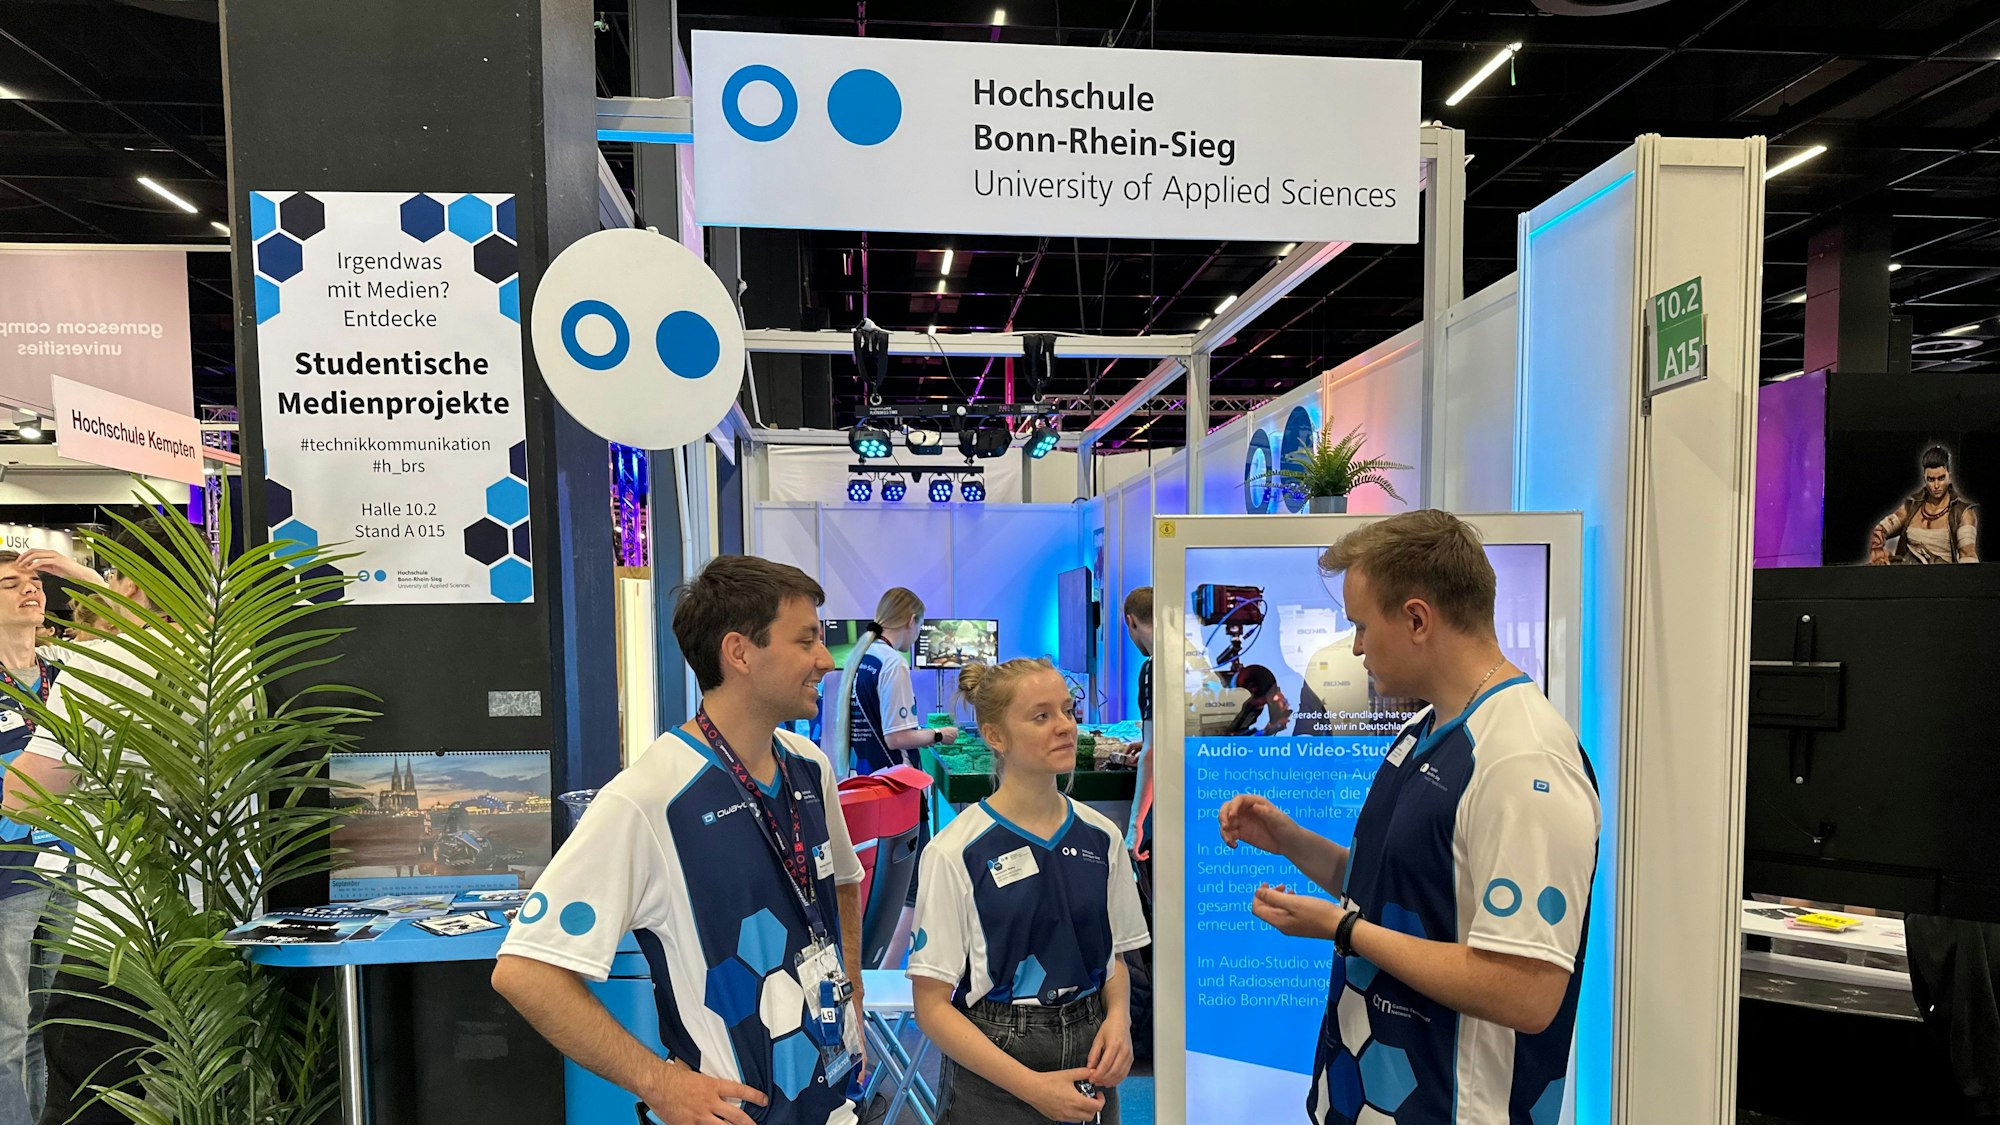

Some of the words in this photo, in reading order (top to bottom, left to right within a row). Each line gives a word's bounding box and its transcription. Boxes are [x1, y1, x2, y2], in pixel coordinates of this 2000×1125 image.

[974, 79, 1154, 112] Hochschule
[974, 124, 1236, 166] Bonn-Rhein-Sieg
[974, 168, 1113, 207] University
[1124, 173, 1152, 202] of
[1162, 175, 1270, 209] Applied
[1282, 178, 1397, 208] Sciences
[338, 251, 442, 274] Irgendwas
[328, 281, 361, 298] mit
[367, 281, 449, 299] Medien?
[1657, 283, 1699, 323] 10.2
[344, 309, 437, 327] Entdecke
[295, 350, 489, 375] Studentische
[1663, 336, 1700, 380] A15
[278, 390, 509, 420] Medienprojekte
[71, 409, 146, 446] Hochschule
[148, 430, 196, 459] Kempten
[300, 437, 491, 452] #technikkommunikation
[372, 458, 426, 475] #h_brs
[362, 502, 401, 516] Halle
[406, 502, 437, 516] 10.2
[355, 524, 400, 538] Stand
[404, 525, 415, 538] A
[418, 525, 445, 538] 015
[6, 535, 30, 549] USK
[1324, 711, 1337, 719] die
[1339, 711, 1384, 721] Grundlage
[1386, 711, 1399, 719] hat
[1313, 722, 1332, 731] dass
[1334, 722, 1347, 731] wir
[1349, 722, 1358, 731] in
[1197, 743, 1253, 758] Audio-
[1259, 743, 1291, 758] und
[1197, 768, 1219, 781] Die
[1224, 767, 1347, 784] hochschuleigenen
[1340, 786, 1361, 799] die
[1295, 805, 1342, 818] Inhalte
[1197, 844, 1209, 855] In
[1197, 862, 1275, 878] Sendungen
[1197, 880, 1224, 893] und
[1197, 919, 1255, 931] erneuert
[1197, 956, 1215, 969] Im
[1219, 955, 1309, 969] Audio-Studio
[1198, 974, 1224, 988] und
[1199, 993, 1236, 1006] Radio
